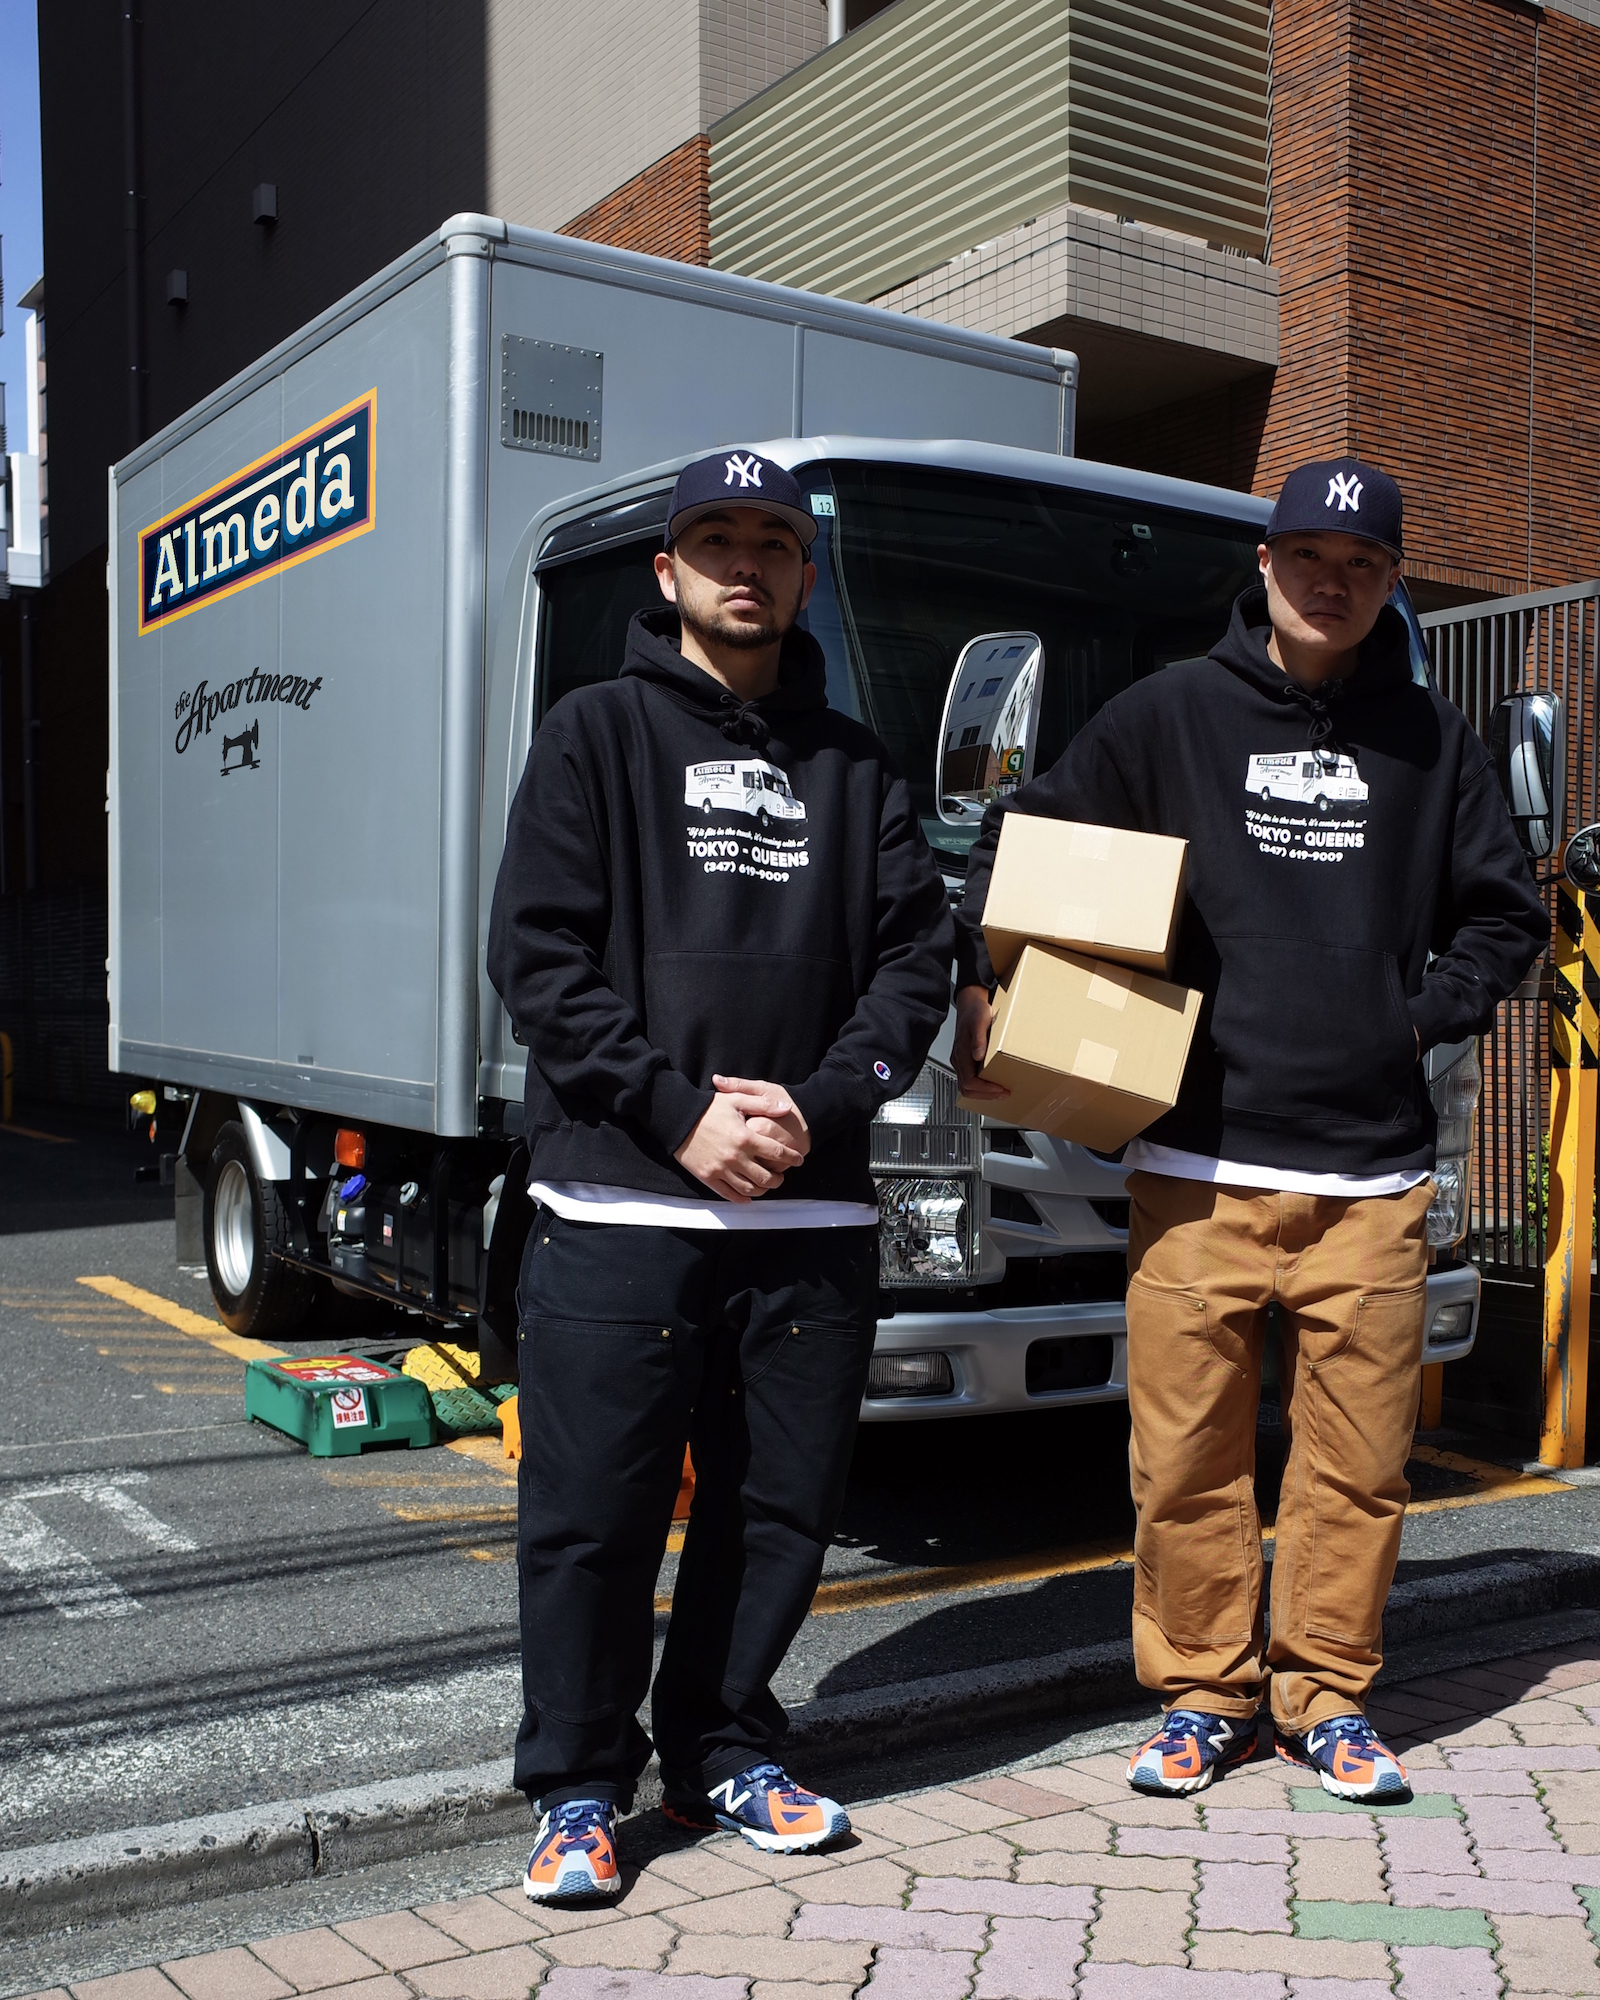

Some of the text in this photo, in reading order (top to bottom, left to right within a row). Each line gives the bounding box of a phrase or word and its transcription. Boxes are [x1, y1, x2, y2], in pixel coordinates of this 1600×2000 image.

[150, 425, 355, 607] Almeda
[820, 501, 832, 514] 12
[175, 666, 323, 754] the Apartment
[695, 764, 733, 775] Almeda
[1257, 757, 1293, 766] Almeda
[1245, 821, 1291, 843] TOKYO
[1304, 831, 1364, 848] QUEENS
[686, 841, 739, 857] TOKYO
[751, 846, 809, 867] QUEENS
[1258, 842, 1344, 863] (347) 619-9009
[703, 861, 790, 882] (347) 619-9009
